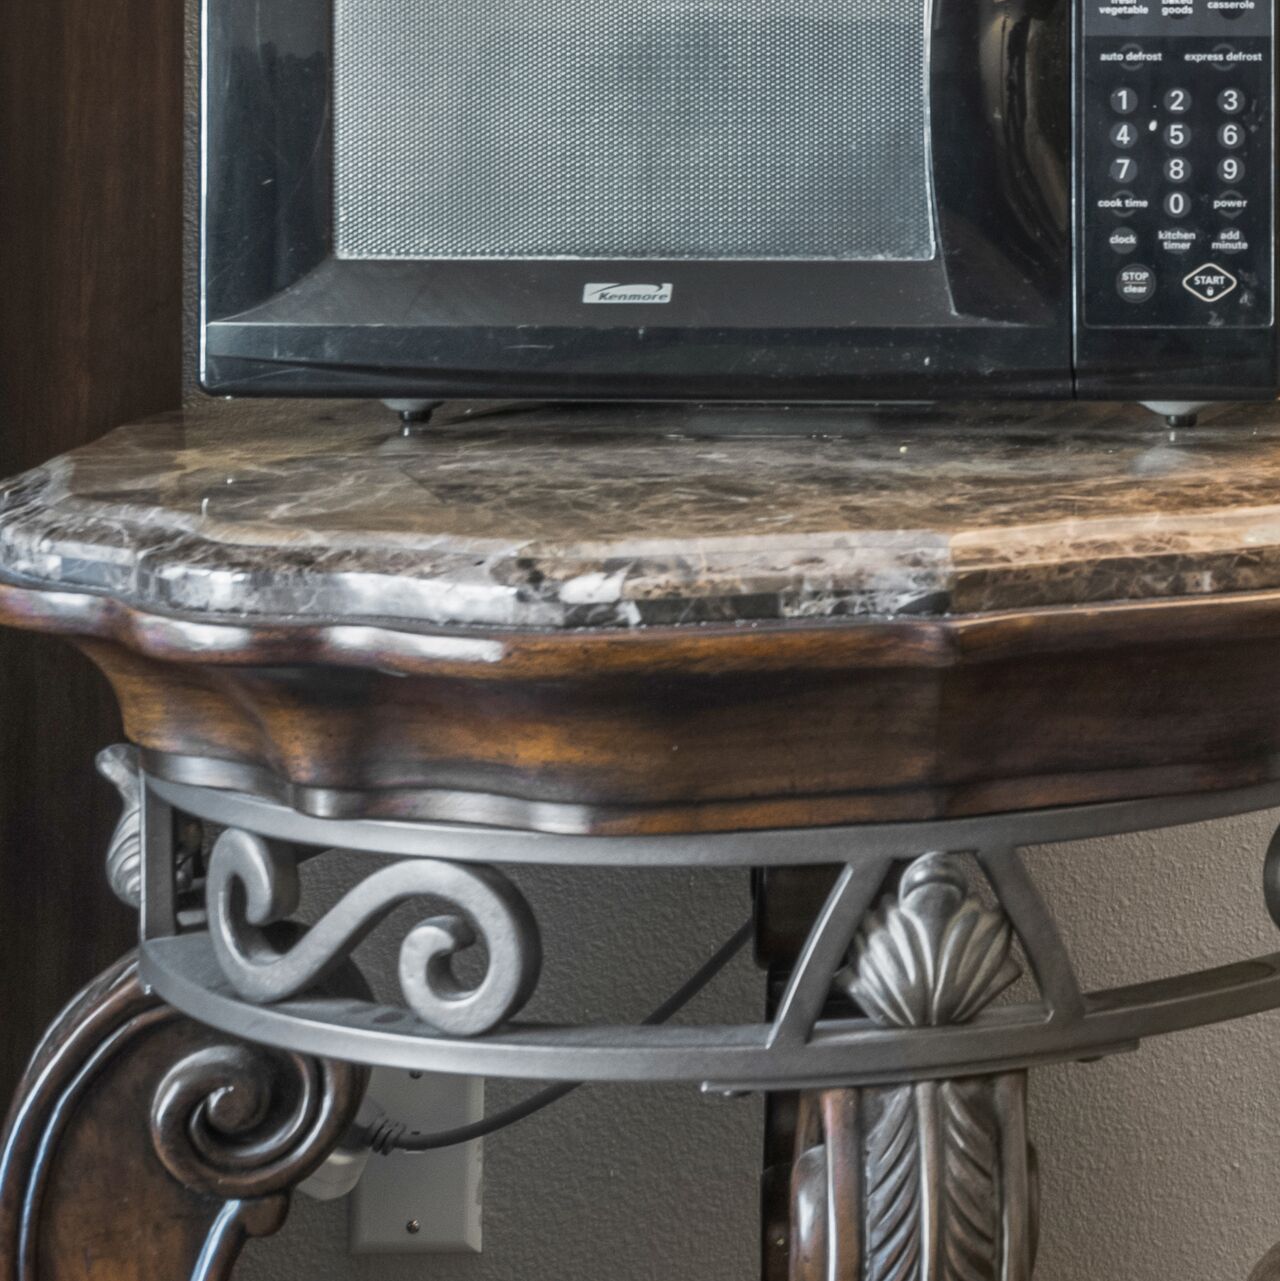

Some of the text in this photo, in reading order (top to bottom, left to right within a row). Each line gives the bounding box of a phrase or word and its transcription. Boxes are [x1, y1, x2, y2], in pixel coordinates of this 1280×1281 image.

[1207, 0, 1255, 9] casserole
[1098, 5, 1149, 16] vegetable
[1161, 6, 1193, 16] goods
[1100, 51, 1162, 61] auto defrost
[1184, 51, 1262, 62] express defrost
[1117, 90, 1128, 110] 1
[1169, 90, 1184, 110] 2
[1223, 90, 1238, 110] 3
[1116, 124, 1130, 144] 4
[1169, 124, 1184, 144] 5
[1223, 124, 1238, 144] 6
[1116, 159, 1130, 179] 7
[1169, 159, 1184, 179] 8
[1223, 159, 1238, 179] 9
[1098, 198, 1148, 208] cook time
[1169, 193, 1184, 214] 0
[1213, 200, 1247, 209] power
[1109, 234, 1136, 244] clock
[1158, 230, 1196, 240] kitchen
[1220, 230, 1240, 240] add
[1163, 240, 1191, 250] timer
[1211, 240, 1248, 250] minute
[1121, 271, 1149, 281] STOP
[1194, 276, 1225, 285] START
[1123, 284, 1147, 293] clear
[598, 292, 668, 301] Kenmore
